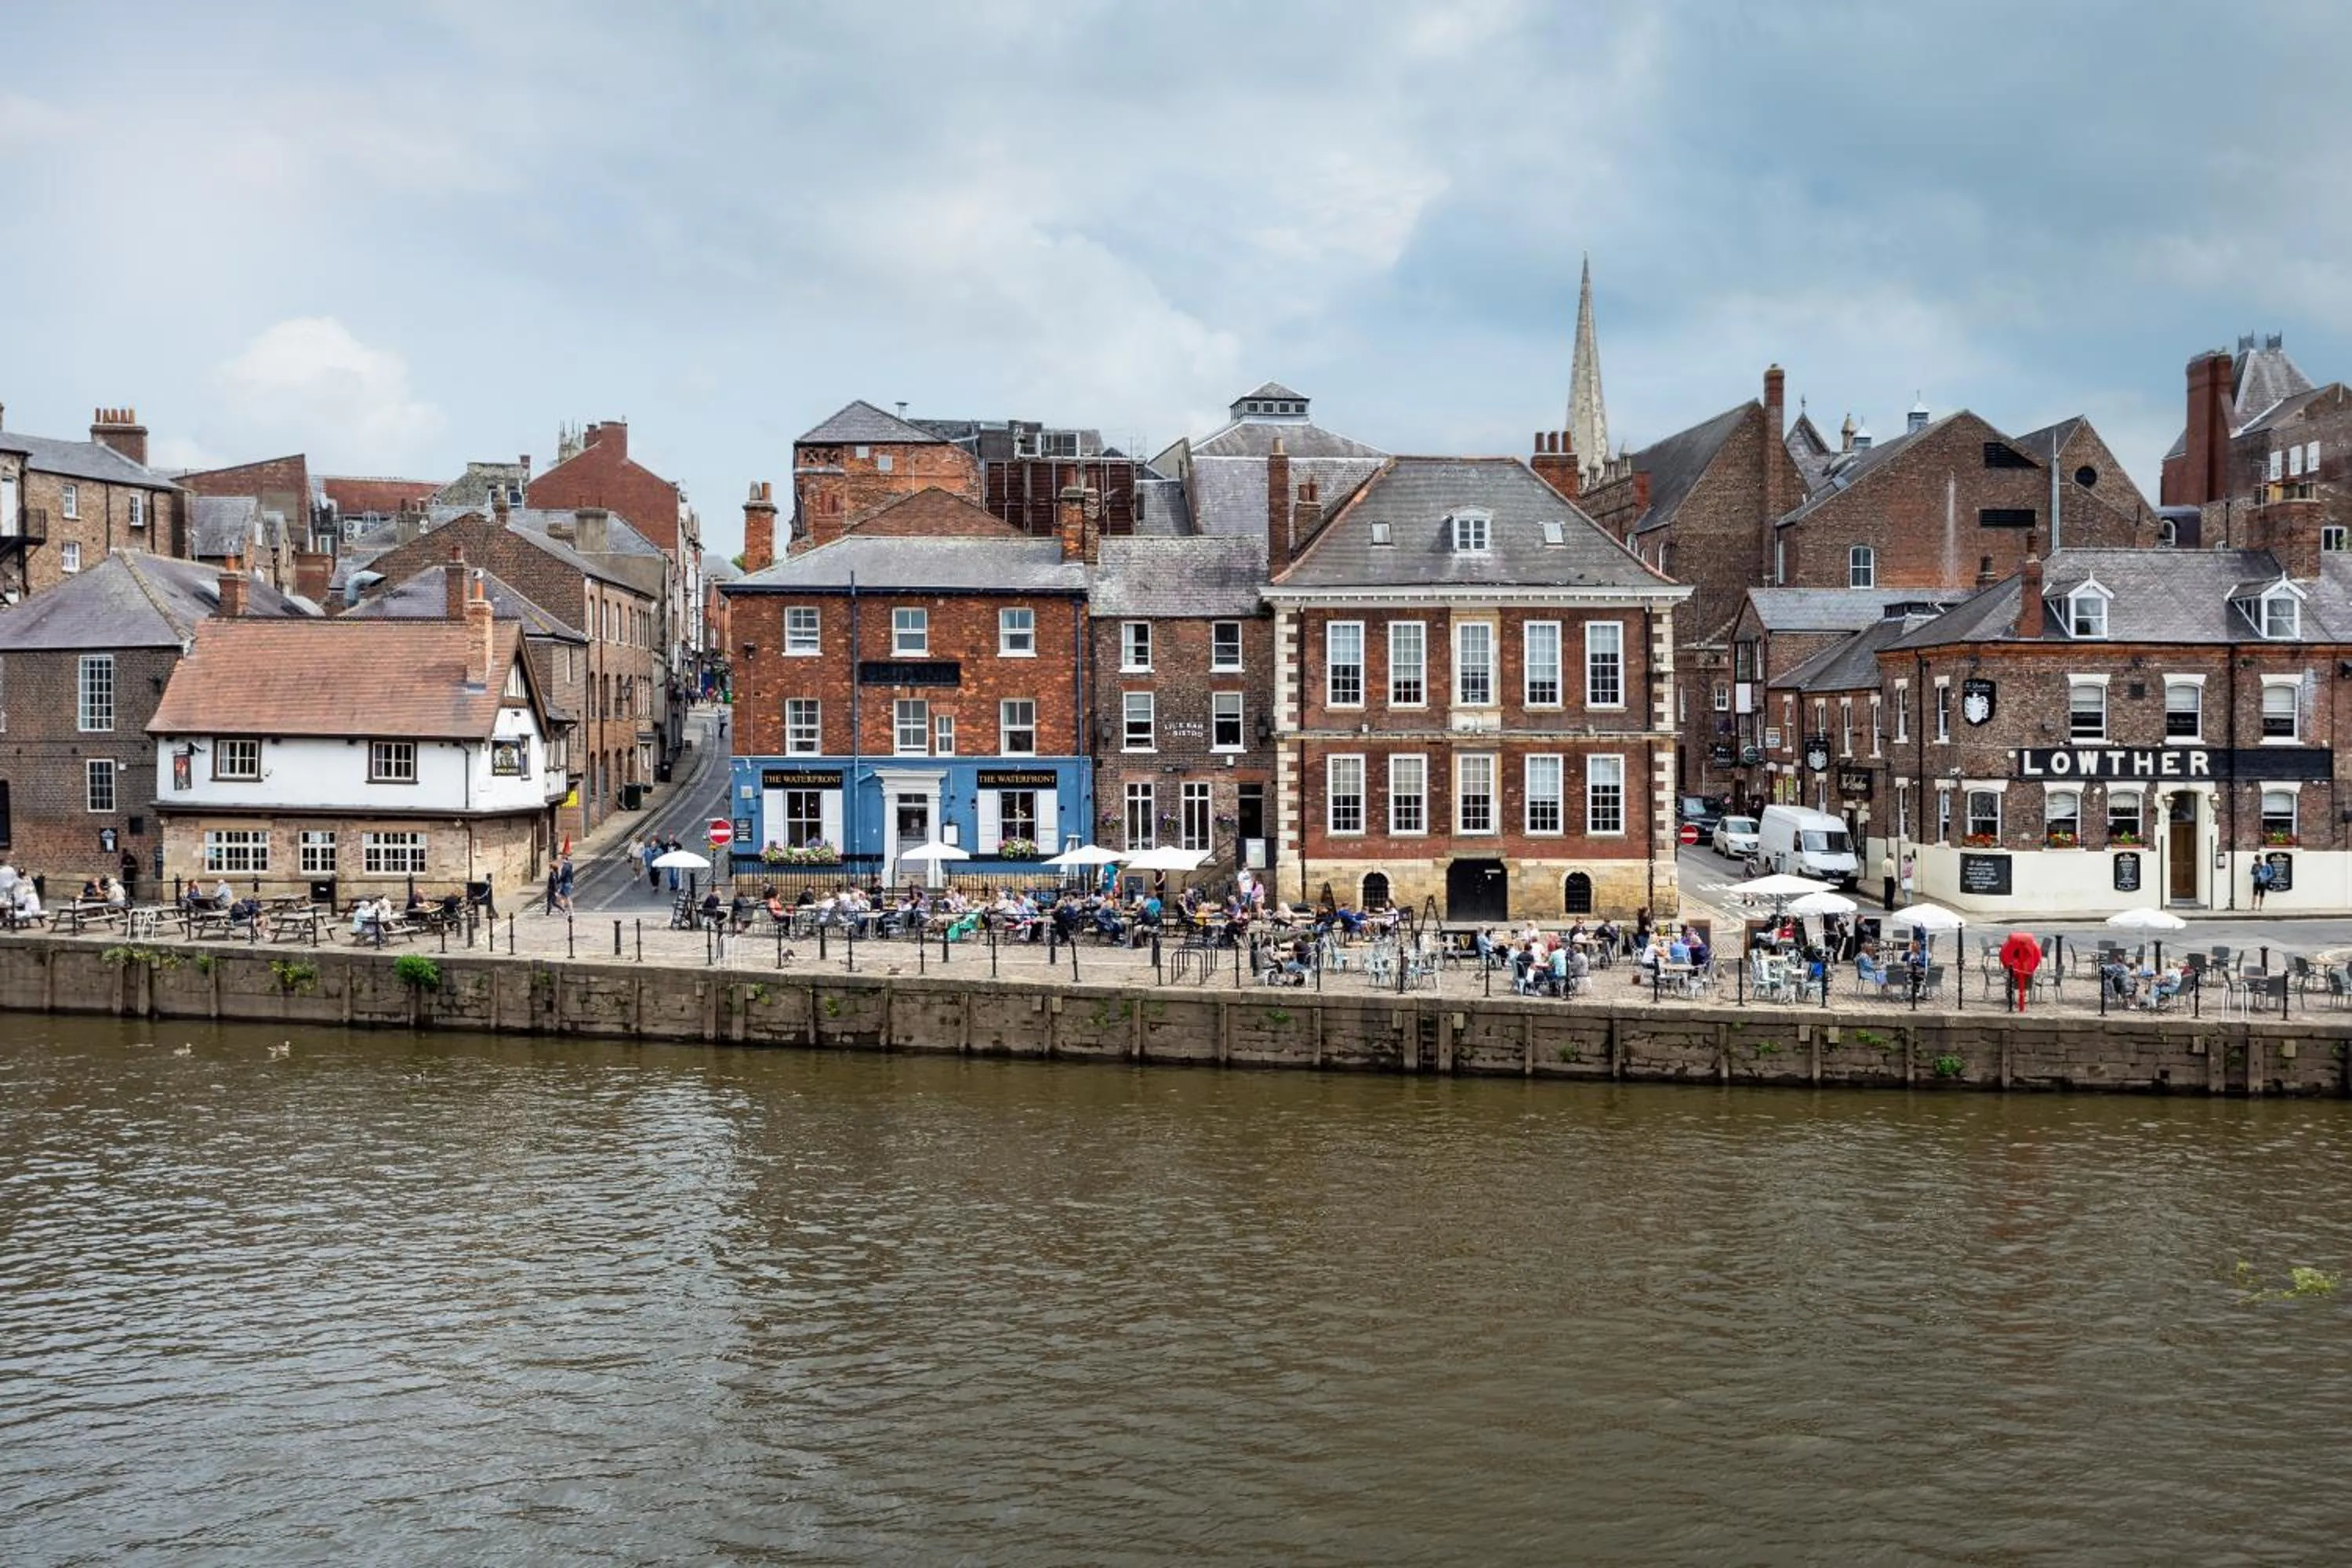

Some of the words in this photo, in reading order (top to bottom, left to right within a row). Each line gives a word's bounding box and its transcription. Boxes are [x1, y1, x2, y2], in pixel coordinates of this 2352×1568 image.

[2023, 750, 2211, 775] LOWTHER
[764, 775, 782, 783] THE
[783, 775, 842, 783] WATERFRONT
[978, 775, 996, 783] THE
[996, 775, 1056, 783] WATERFRONT
